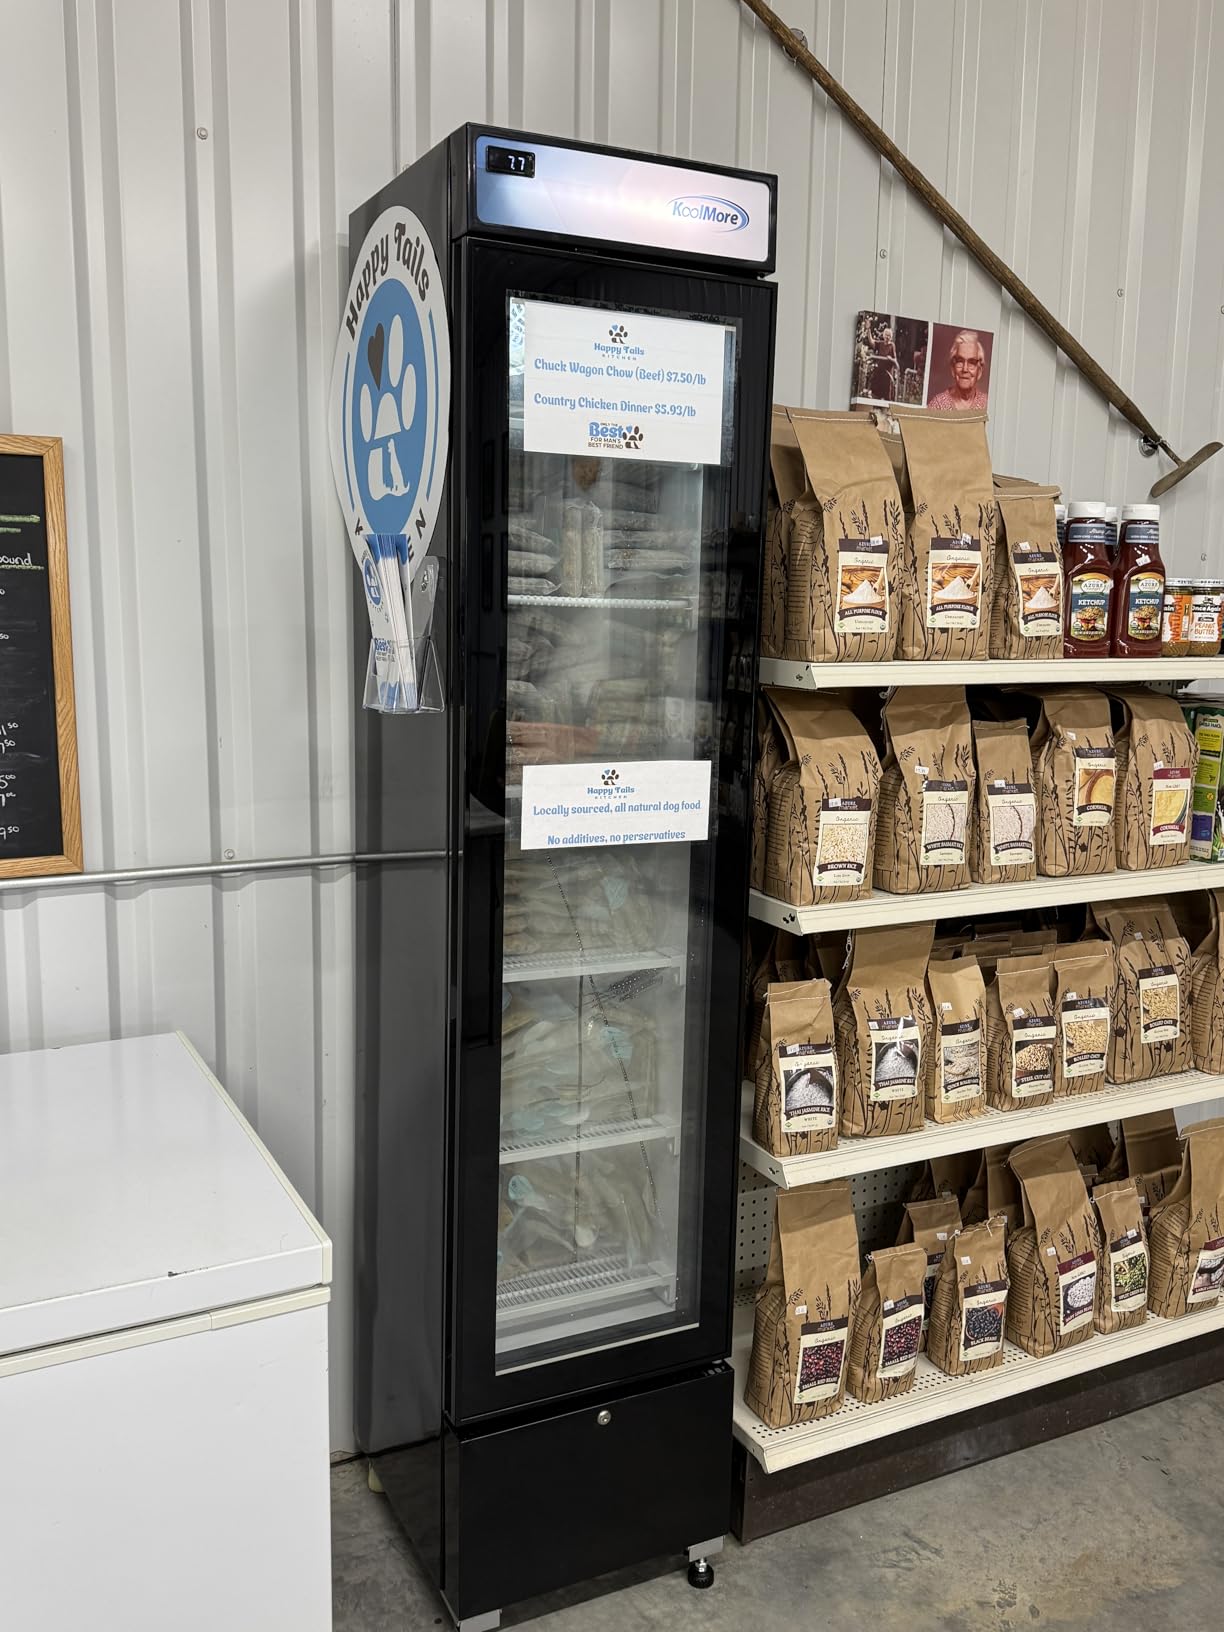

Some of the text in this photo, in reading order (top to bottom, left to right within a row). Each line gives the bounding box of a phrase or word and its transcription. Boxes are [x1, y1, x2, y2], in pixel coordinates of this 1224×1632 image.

[672, 201, 739, 225] KoolMore
[346, 222, 430, 341] Happy Tails
[594, 343, 645, 355] Happy Tails
[534, 358, 706, 385] Chuck Wagon Chow (Beef) $7.50/lb
[534, 393, 696, 417] Country Chicken Dinner $5.93/lb
[589, 421, 623, 438] Best
[0, 553, 33, 566] ound
[587, 785, 636, 795] Happy Tails
[533, 800, 701, 818] Locally sourced, all natural dog food
[547, 829, 686, 845] No additives, no perservatives
